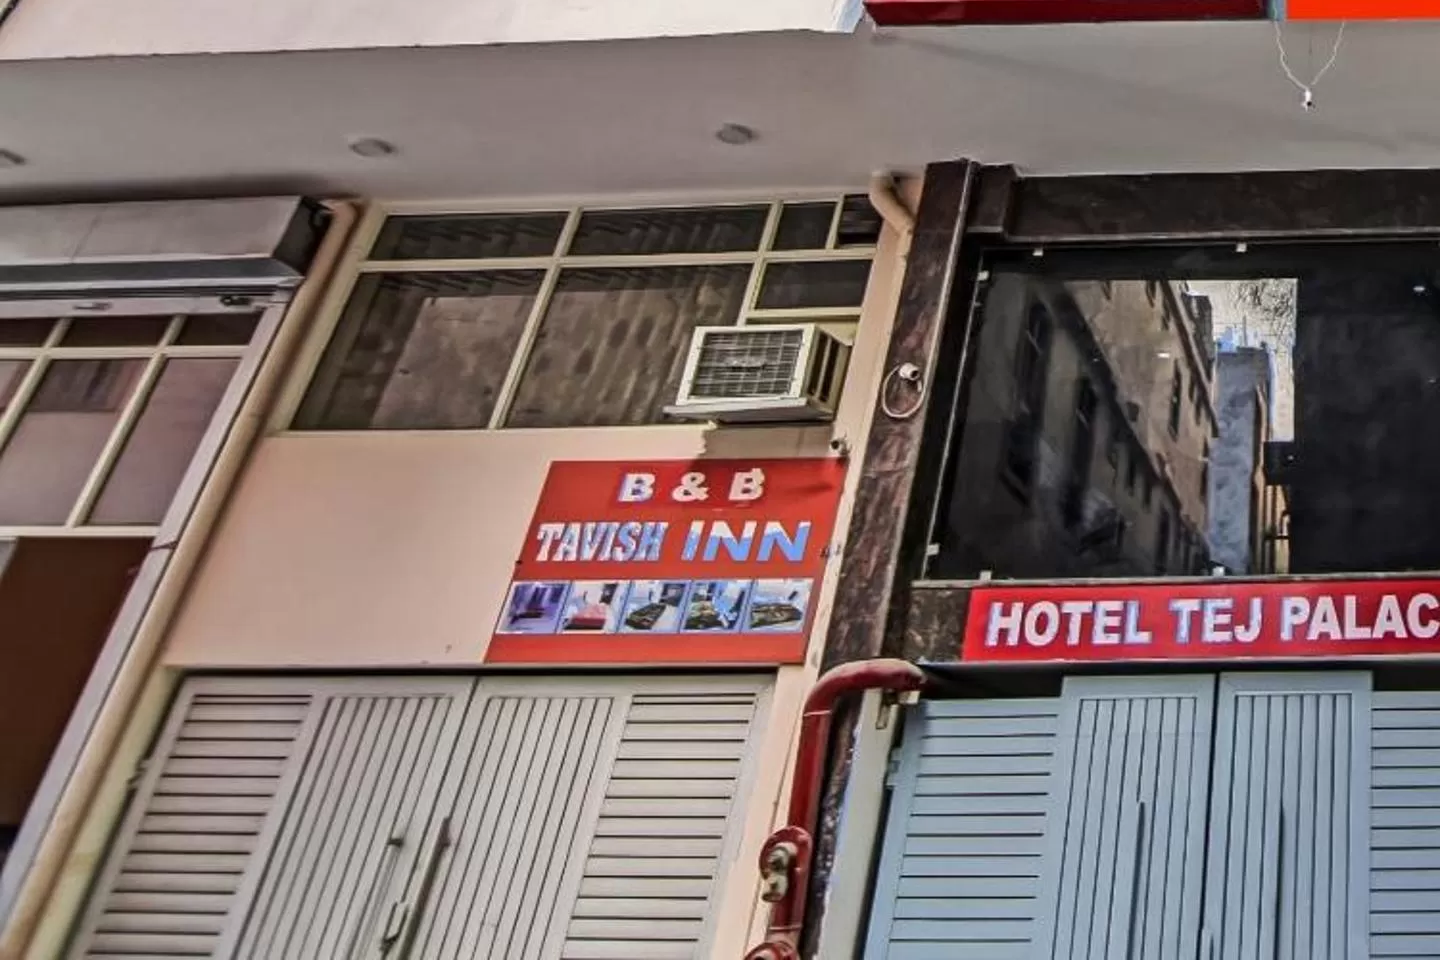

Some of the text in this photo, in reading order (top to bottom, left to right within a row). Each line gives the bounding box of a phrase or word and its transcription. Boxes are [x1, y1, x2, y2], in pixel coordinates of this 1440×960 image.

[617, 467, 766, 503] B & B
[534, 519, 813, 563] TAVISH INN
[984, 600, 1153, 646] HOTEL
[1168, 597, 1264, 643] TEJ
